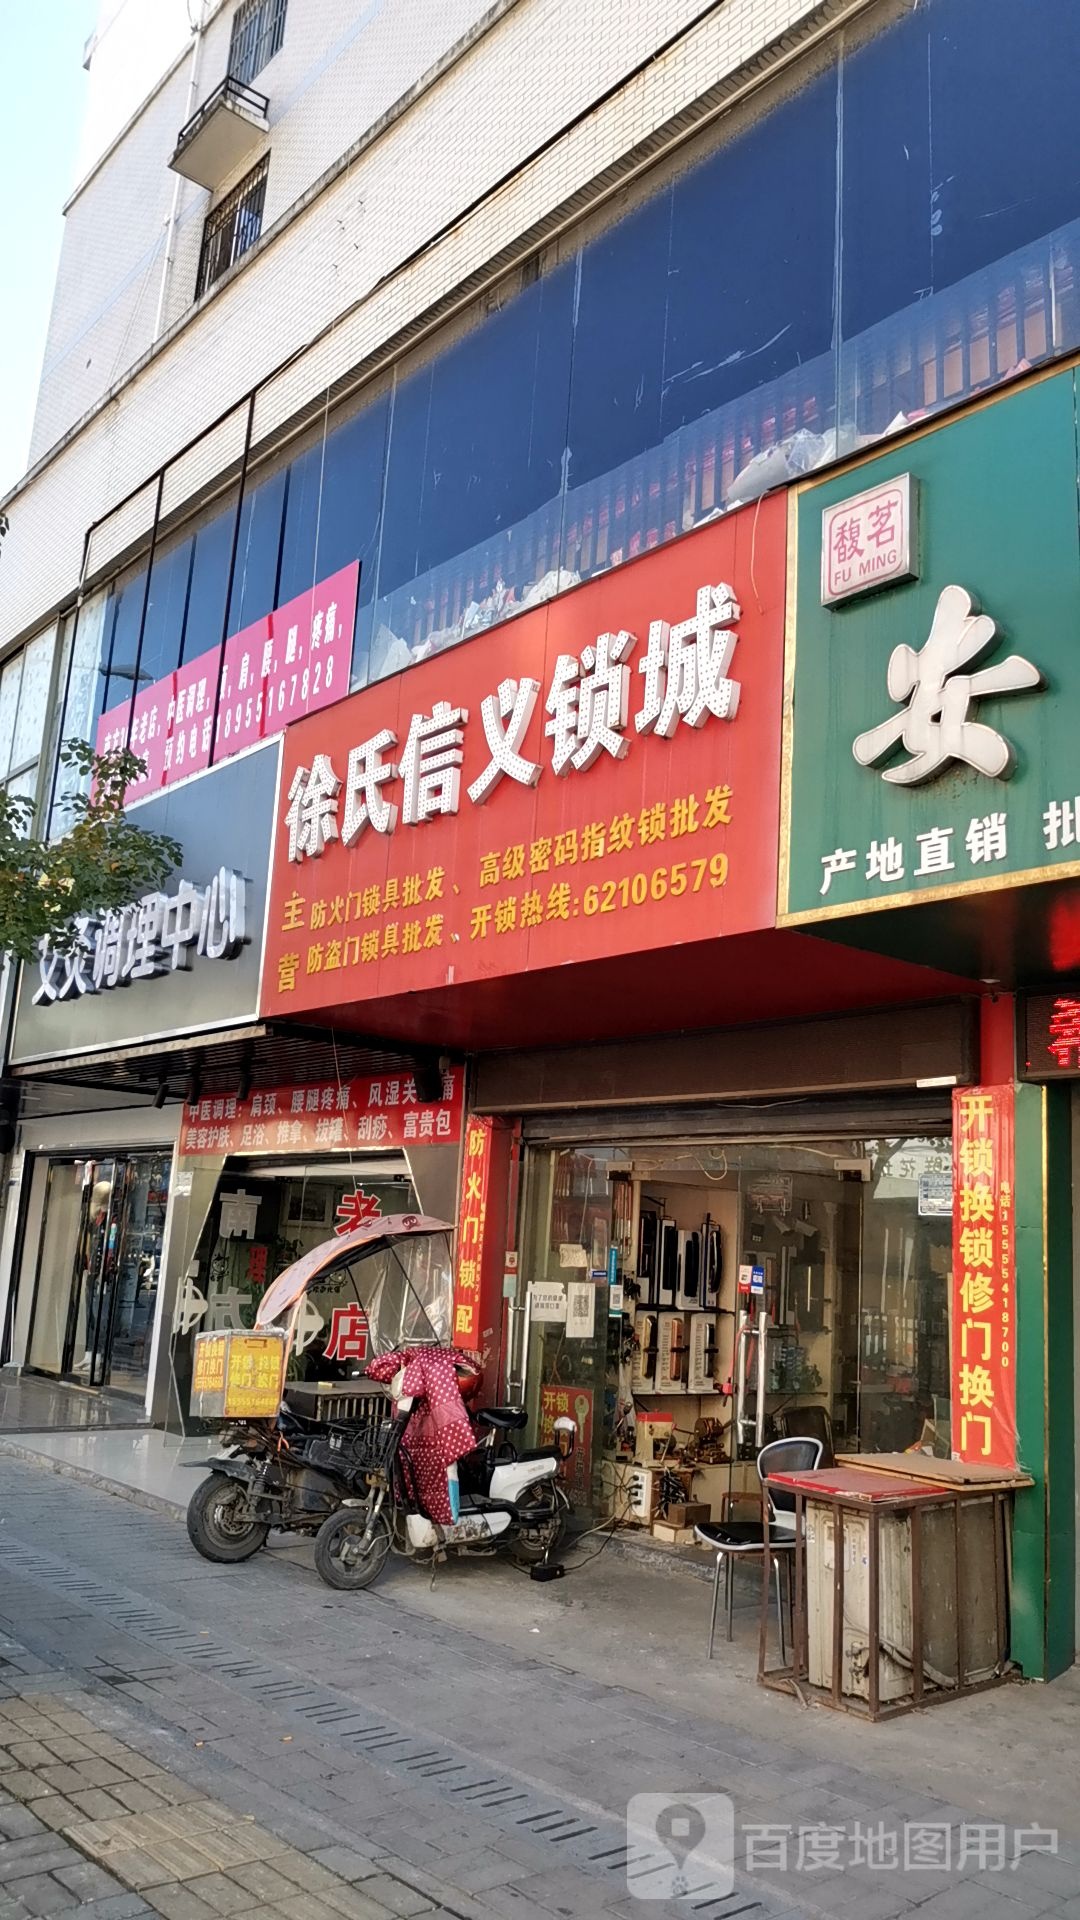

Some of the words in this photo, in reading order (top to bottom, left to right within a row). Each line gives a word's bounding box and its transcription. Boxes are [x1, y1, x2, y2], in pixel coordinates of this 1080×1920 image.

[833, 499, 898, 565] 馥茗
[834, 569, 852, 583] FU
[858, 549, 897, 577] MING
[282, 582, 741, 865] 徐氏信义锁城
[852, 584, 1042, 786] 安
[819, 812, 1008, 896] 产地直销
[455, 1129, 487, 1334] 防火门锁配
[959, 1095, 994, 1457] 开锁换锁修门换门
